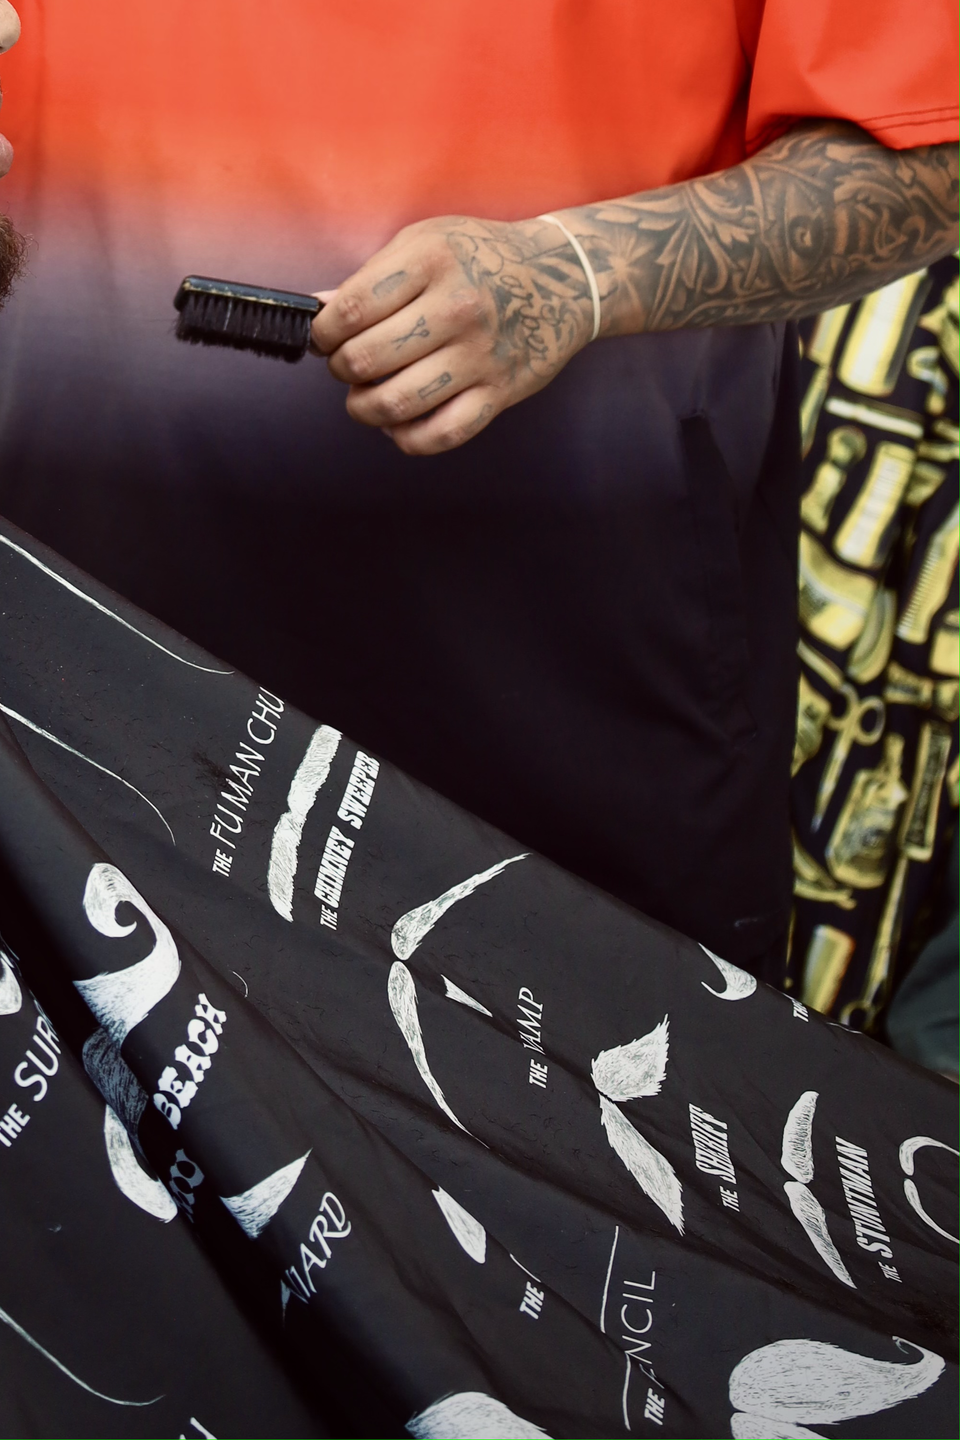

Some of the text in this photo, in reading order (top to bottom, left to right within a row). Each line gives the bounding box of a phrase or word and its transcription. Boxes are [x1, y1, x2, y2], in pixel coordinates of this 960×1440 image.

[212, 848, 233, 877] THE
[247, 686, 286, 745] CHU
[314, 750, 381, 931] THE CHIMNEY SWEEPER
[153, 993, 227, 1130] BEACH
[517, 987, 548, 1088] THE VAMP
[689, 1103, 740, 1212] THE SHERIFF
[835, 1136, 902, 1283] THE STUNTMAN
[520, 1281, 544, 1319] THE
[644, 1388, 666, 1426] THE
